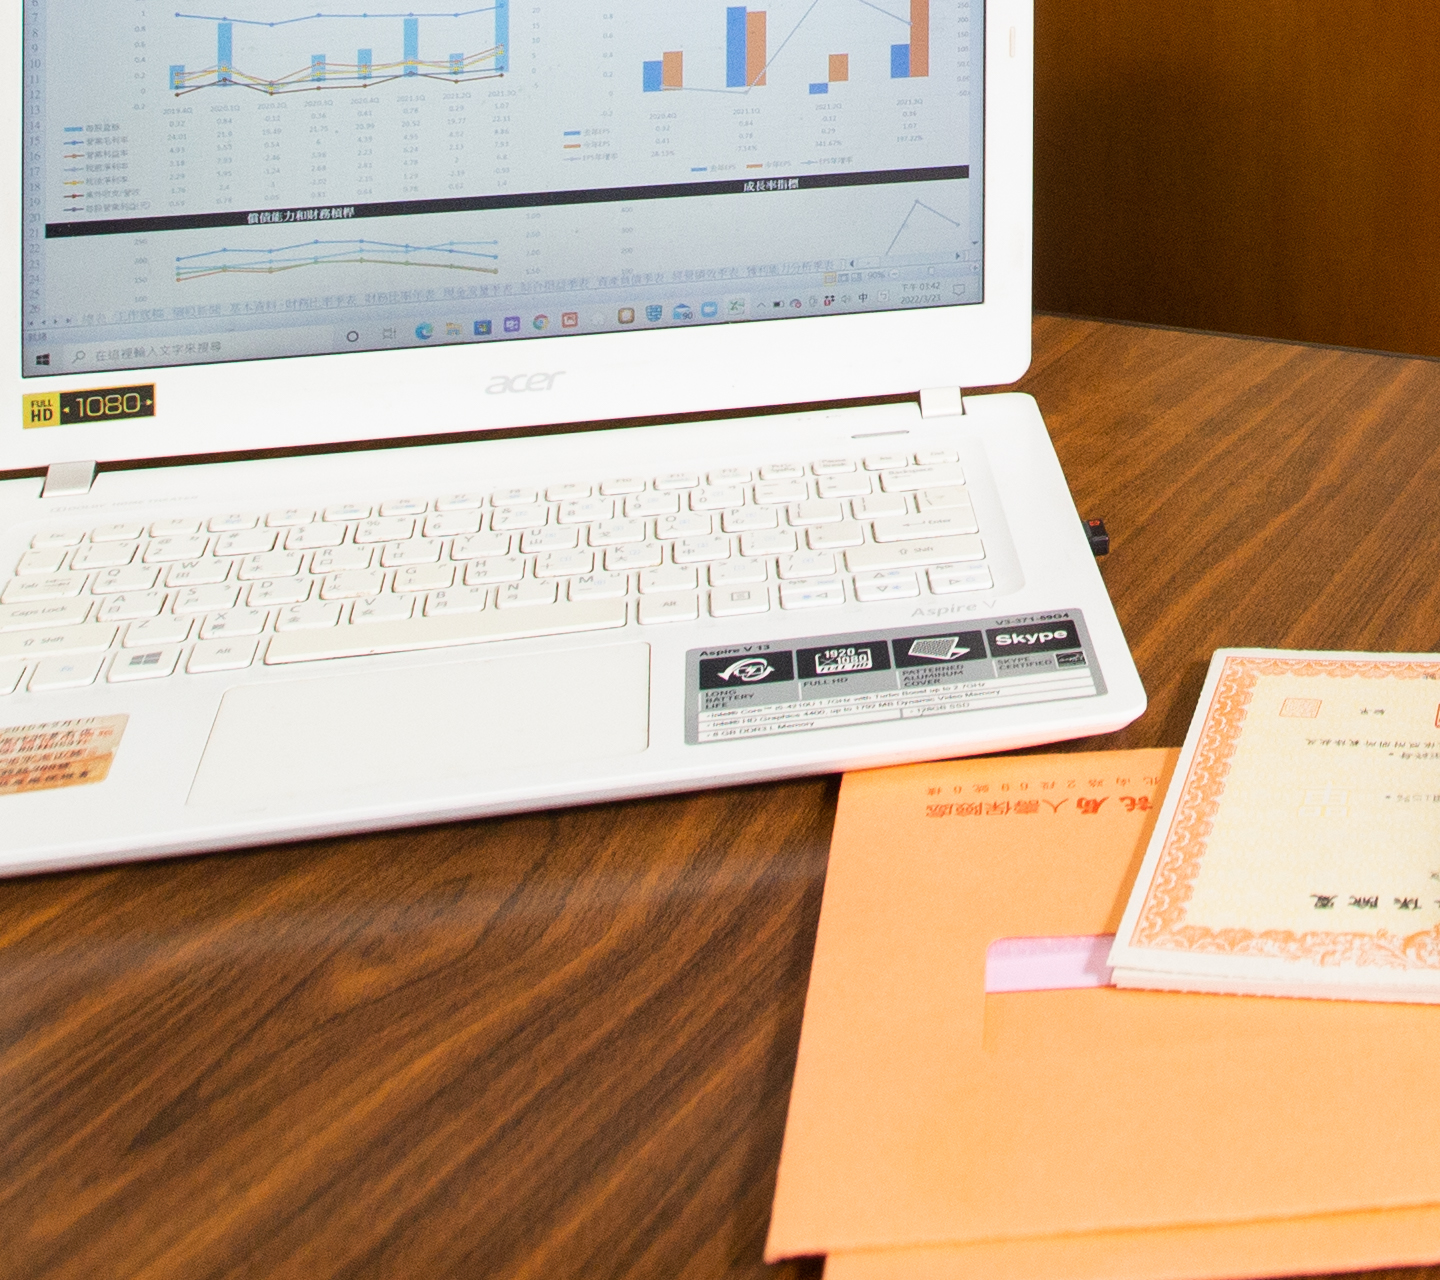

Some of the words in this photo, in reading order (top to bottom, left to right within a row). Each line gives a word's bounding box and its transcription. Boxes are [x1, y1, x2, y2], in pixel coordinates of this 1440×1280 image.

[485, 371, 567, 395] acer
[31, 399, 53, 408] FULL
[75, 393, 141, 417] 1080
[30, 408, 53, 422] HD
[911, 603, 977, 618] Aspire
[983, 599, 997, 609] V
[995, 629, 1068, 646] Skype
[699, 646, 740, 657] Aspire
[824, 648, 855, 659] 1920
[705, 690, 737, 698] LONG
[705, 693, 755, 703] BATTERY
[705, 701, 728, 710] LIFE
